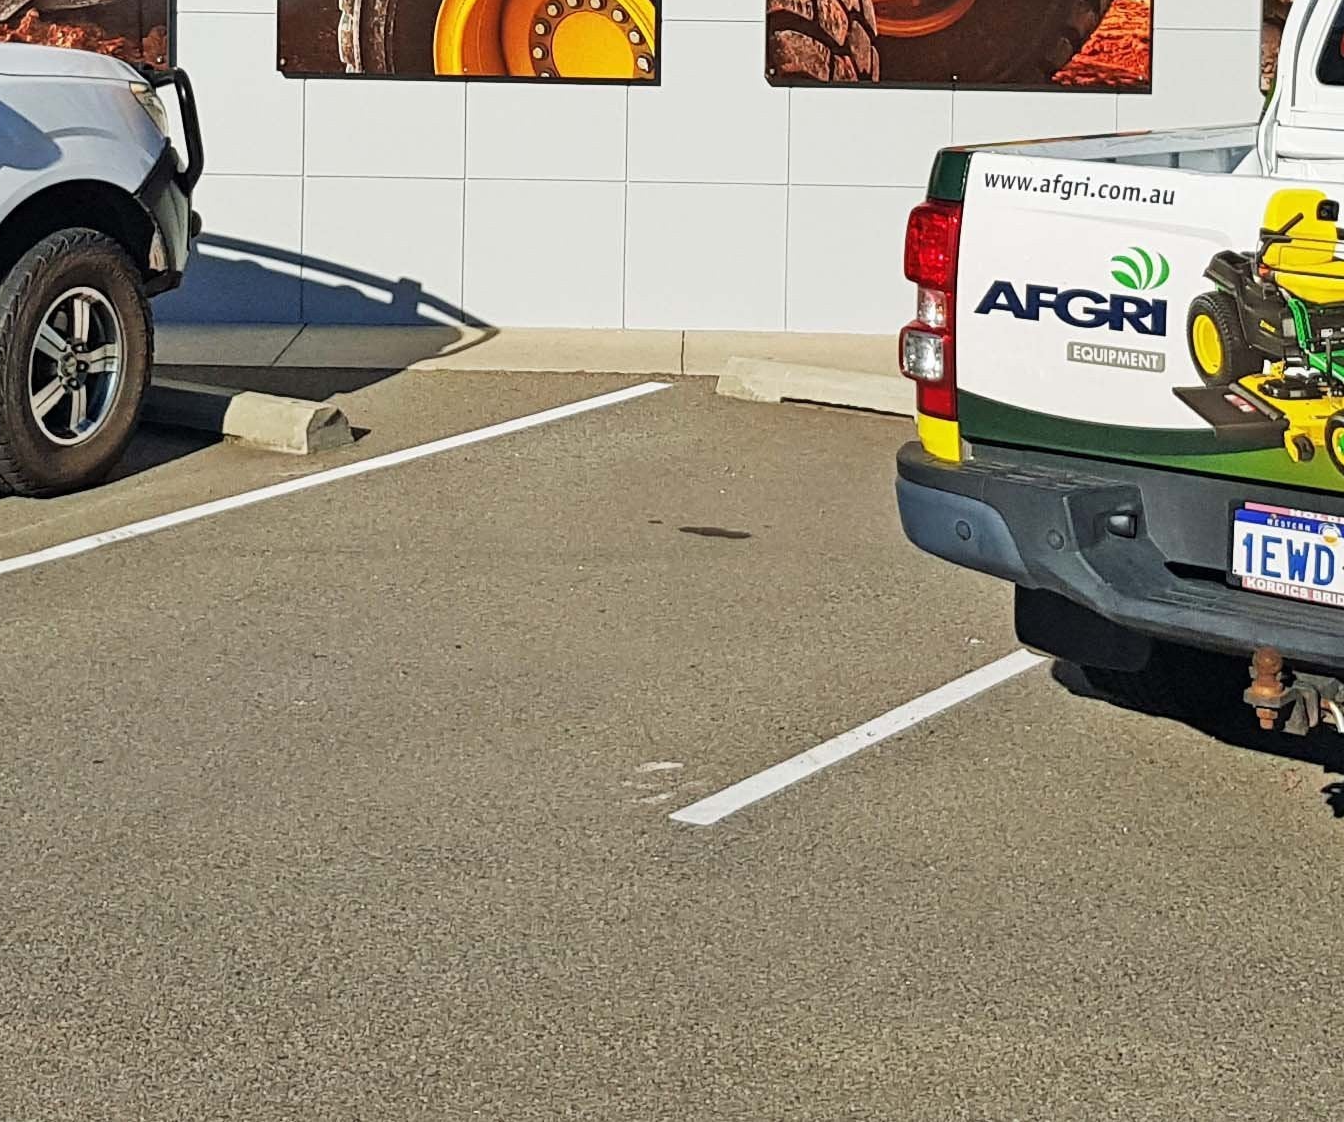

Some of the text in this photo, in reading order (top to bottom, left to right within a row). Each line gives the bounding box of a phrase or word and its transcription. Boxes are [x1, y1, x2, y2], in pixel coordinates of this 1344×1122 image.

[984, 172, 1176, 206] www.afgri.com.au
[973, 279, 1168, 337] AFGRI
[1072, 344, 1159, 370] EQUIPMENT
[1267, 518, 1312, 533] WESTERN
[1246, 576, 1309, 600] KORDICS
